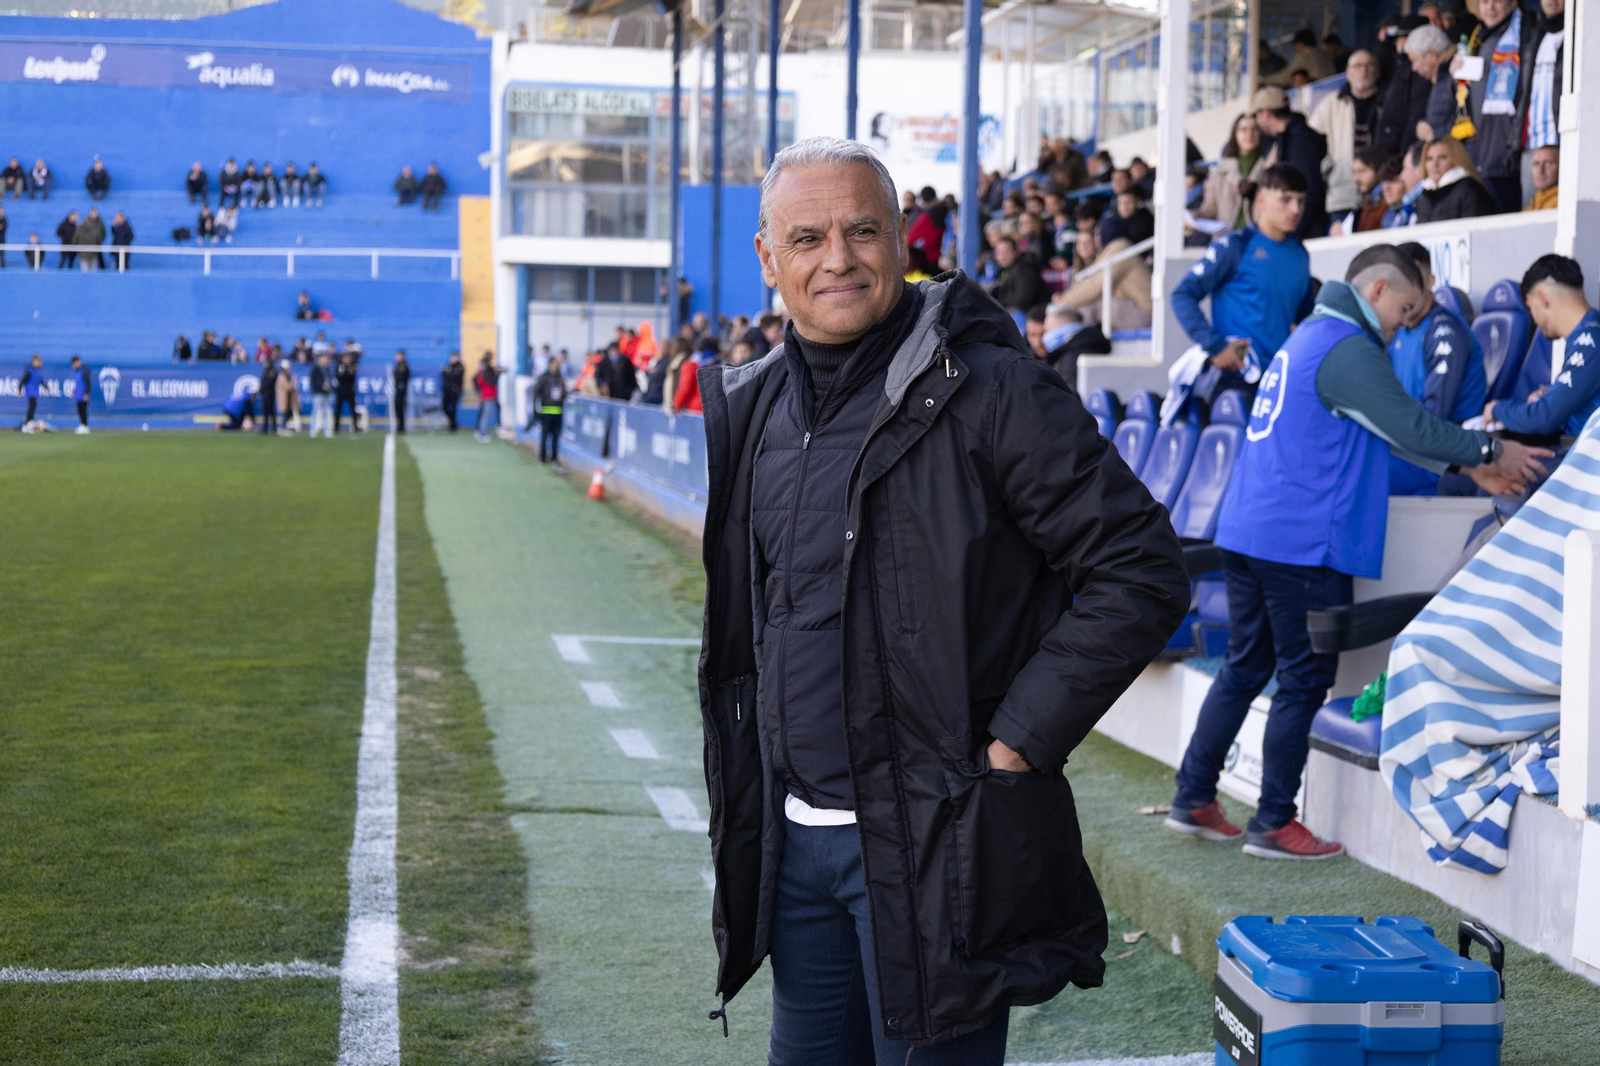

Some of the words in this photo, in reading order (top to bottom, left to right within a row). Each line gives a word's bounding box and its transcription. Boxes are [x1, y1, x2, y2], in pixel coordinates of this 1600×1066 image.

[198, 62, 275, 89] aqualia
[132, 379, 147, 398] EL
[148, 379, 210, 399] ALCOYANO
[1214, 995, 1255, 1056] POWERADE
